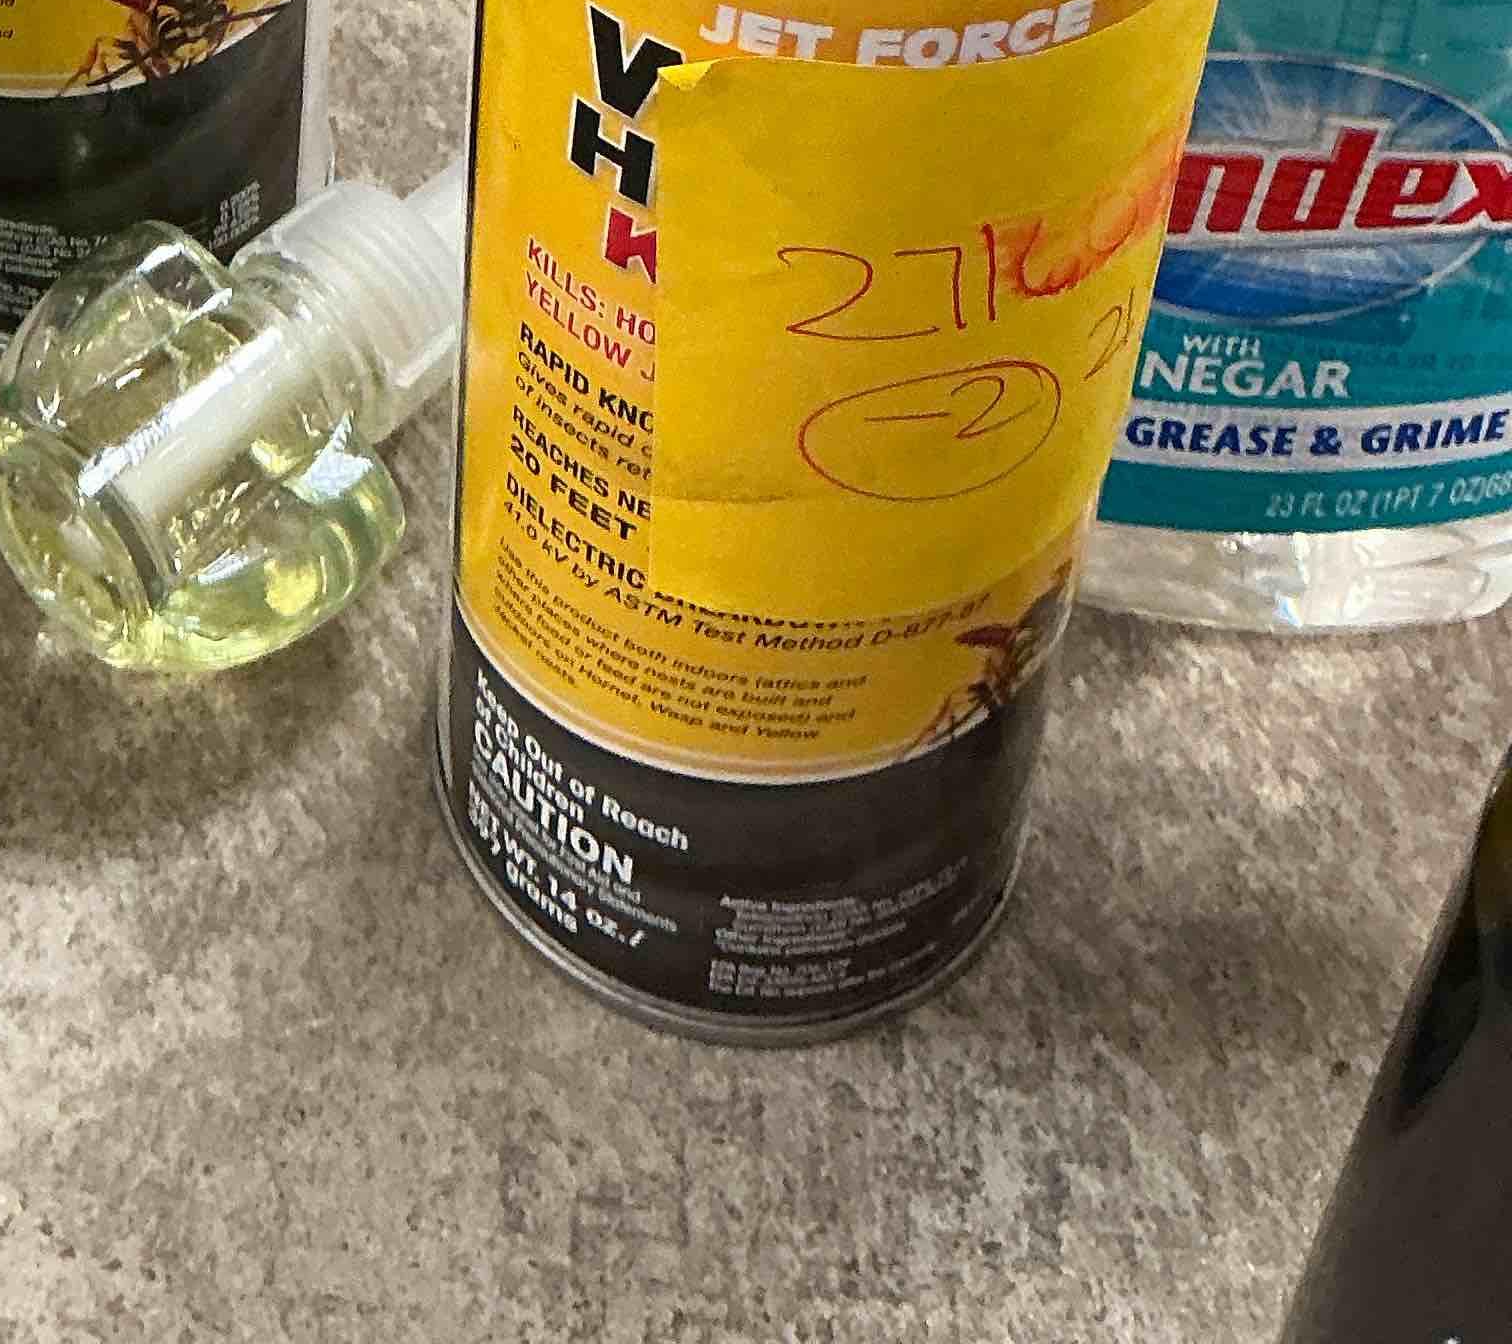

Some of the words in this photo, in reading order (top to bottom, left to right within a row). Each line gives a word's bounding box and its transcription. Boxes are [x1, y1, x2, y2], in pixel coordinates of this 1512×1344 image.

[697, 3, 834, 60] JET
[1168, 127, 1512, 236] ndex
[526, 235, 606, 319] KILLS:
[518, 319, 591, 396] RAPID
[525, 270, 632, 369] YELLOW
[1182, 334, 1263, 358] WITH
[517, 350, 568, 407] Gives
[572, 403, 637, 449] rapid
[1138, 351, 1353, 400] NEGAR
[511, 404, 610, 499] REACHES
[535, 394, 610, 461] insects
[1124, 414, 1297, 457] GREASE
[1308, 424, 1343, 457] &
[1360, 408, 1512, 454] GRIME
[509, 433, 542, 477] 20
[549, 472, 639, 541] FEET
[505, 470, 649, 590] DIELECTRIC
[693, 618, 747, 645] Test
[754, 632, 866, 653] Method
[473, 719, 634, 885] CAUTION
